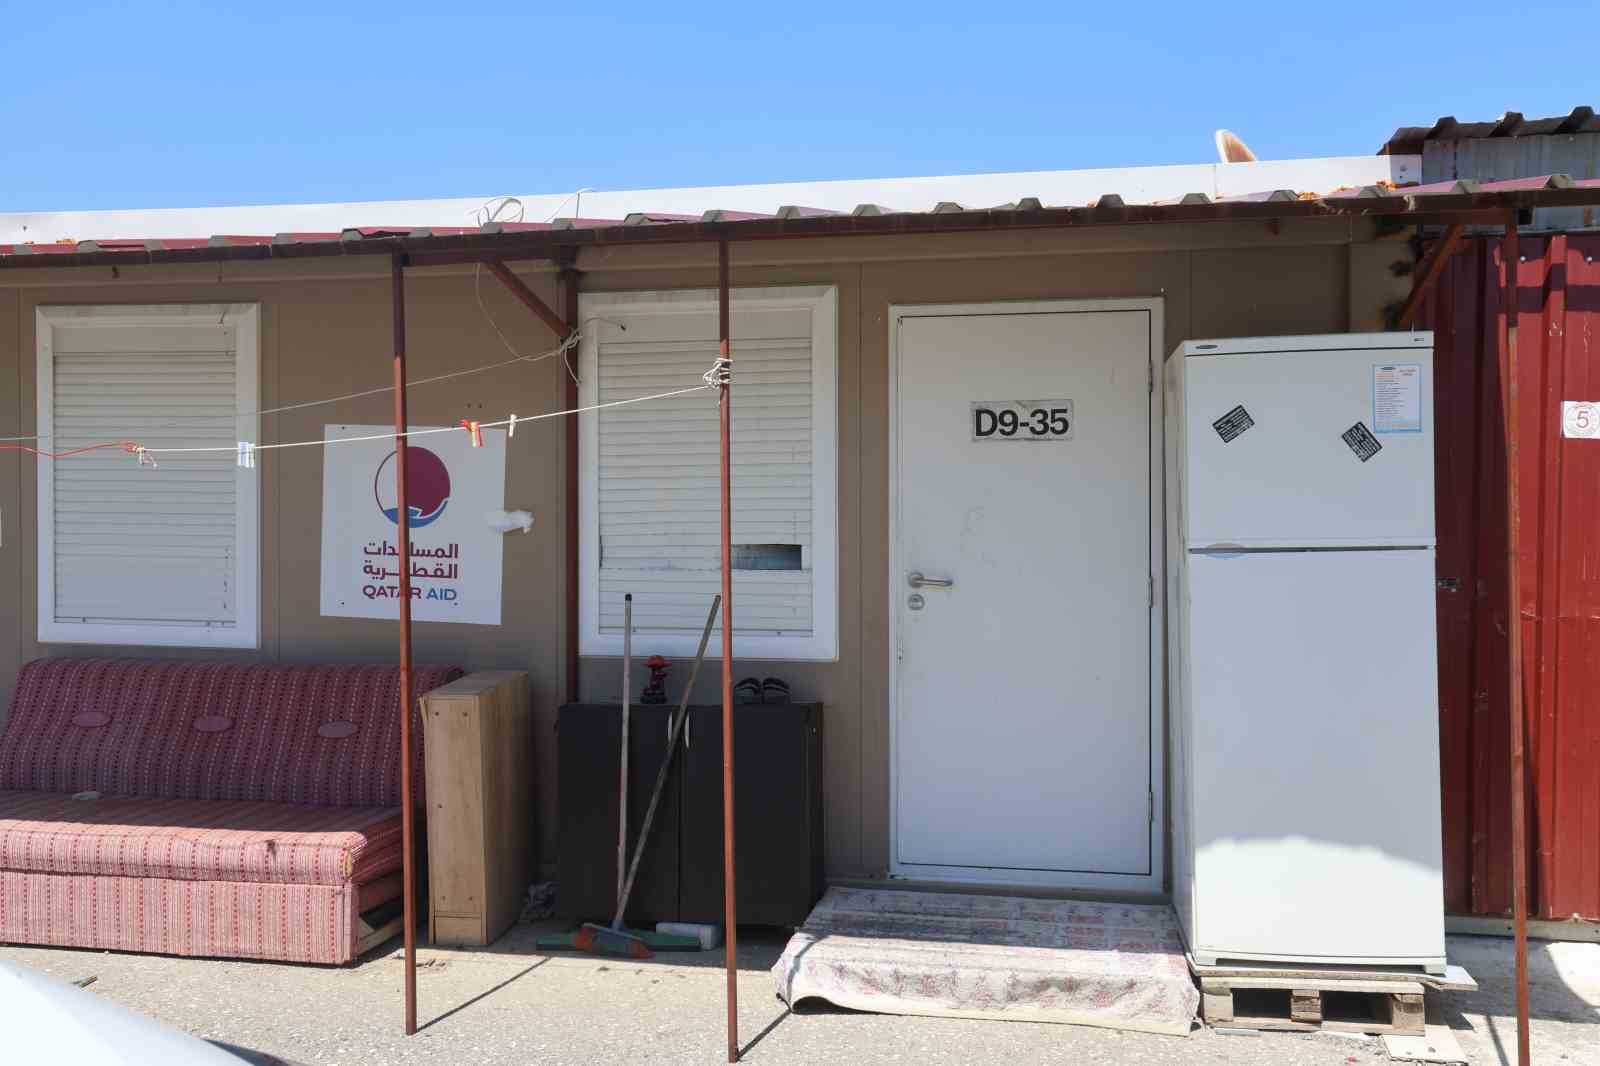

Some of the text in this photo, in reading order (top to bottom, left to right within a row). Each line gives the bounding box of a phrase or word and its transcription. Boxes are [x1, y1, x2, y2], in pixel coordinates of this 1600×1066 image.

[975, 408, 1070, 437] D9-35
[1575, 410, 1590, 429] 5
[363, 540, 459, 559] المسادات
[362, 584, 457, 601] QATR AID
